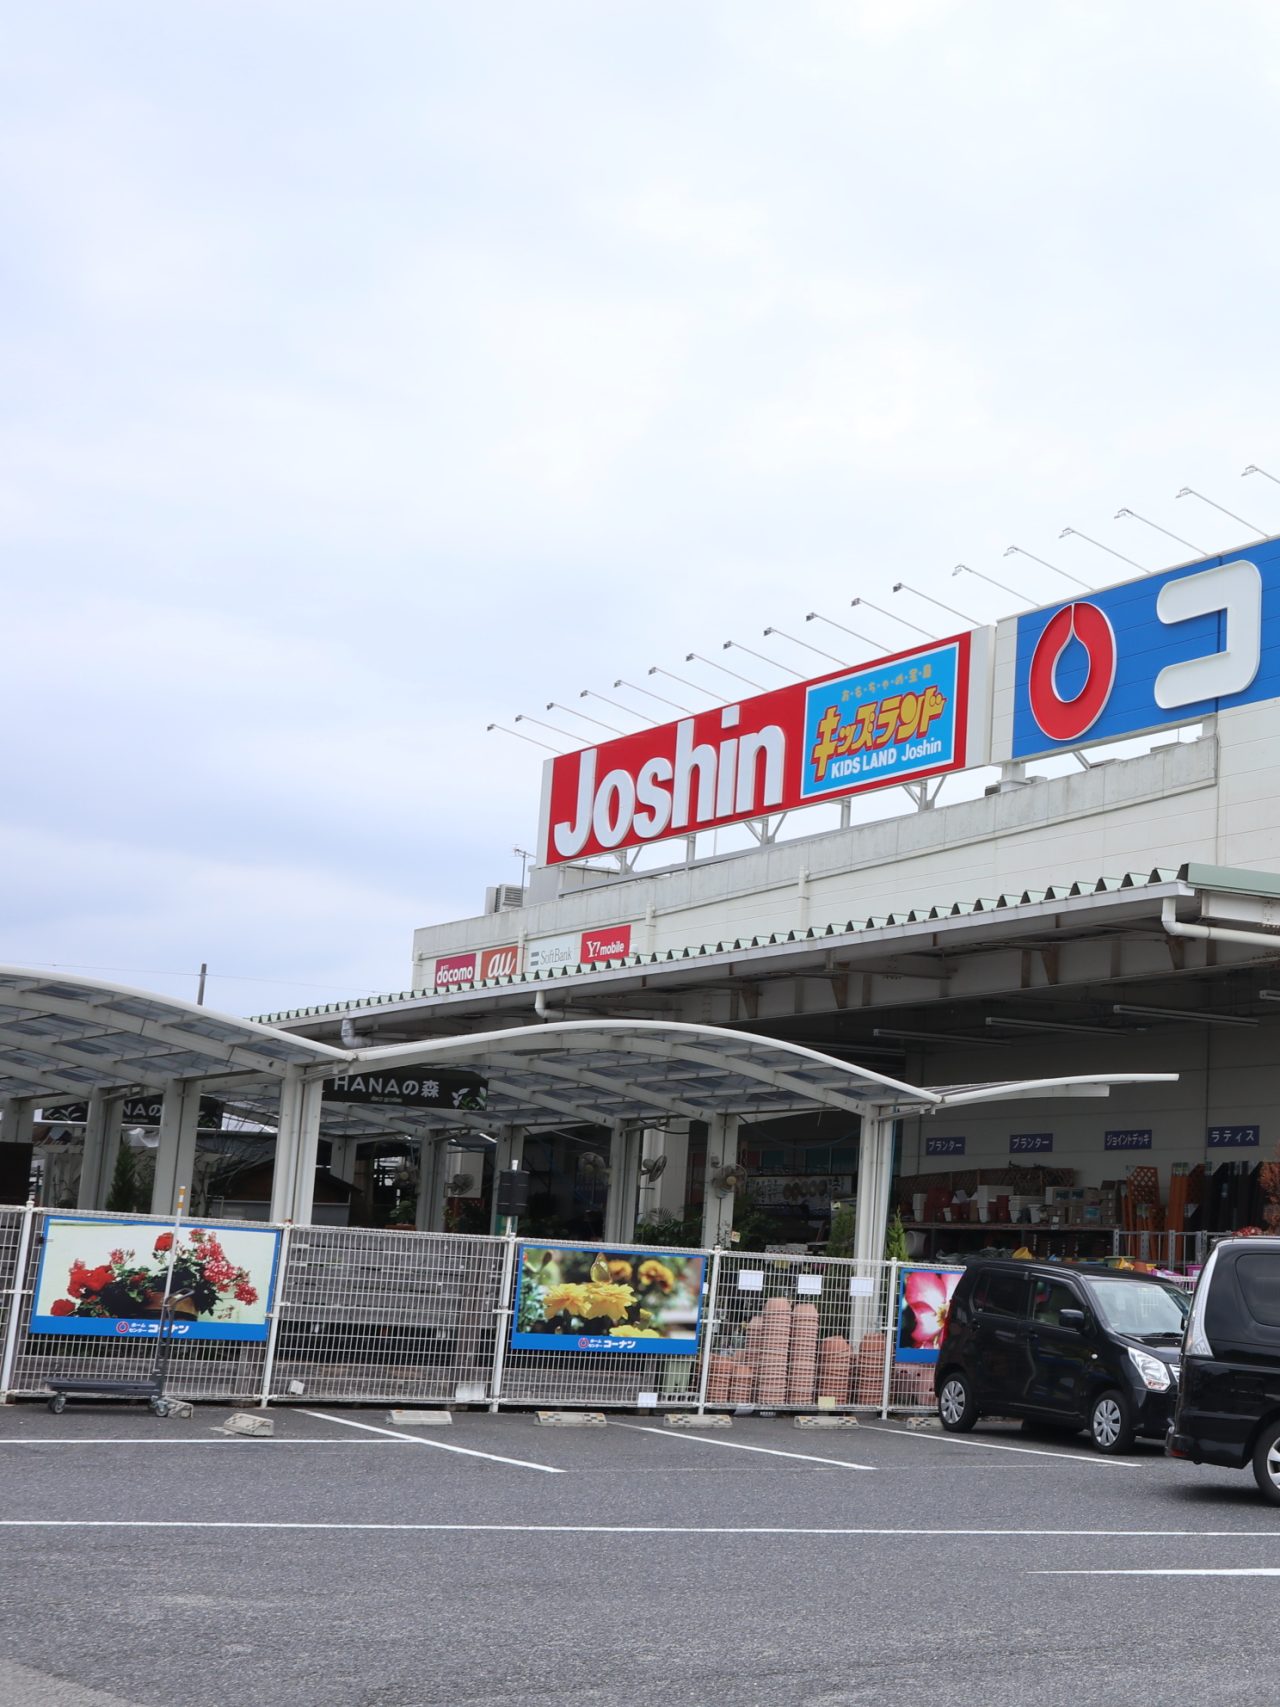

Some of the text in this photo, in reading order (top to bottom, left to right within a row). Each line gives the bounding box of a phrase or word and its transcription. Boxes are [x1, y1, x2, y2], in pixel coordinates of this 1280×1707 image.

[811, 685, 946, 782] キッズランド
[831, 737, 942, 779] KIDS LAND Joshin
[554, 705, 786, 857] Joshin
[487, 951, 516, 978] au
[540, 948, 572, 966] SoftBank
[436, 965, 473, 984] docomo
[333, 1075, 440, 1098] HANAの森
[1211, 1130, 1255, 1143] ラティス
[603, 1339, 637, 1349] コーナン
